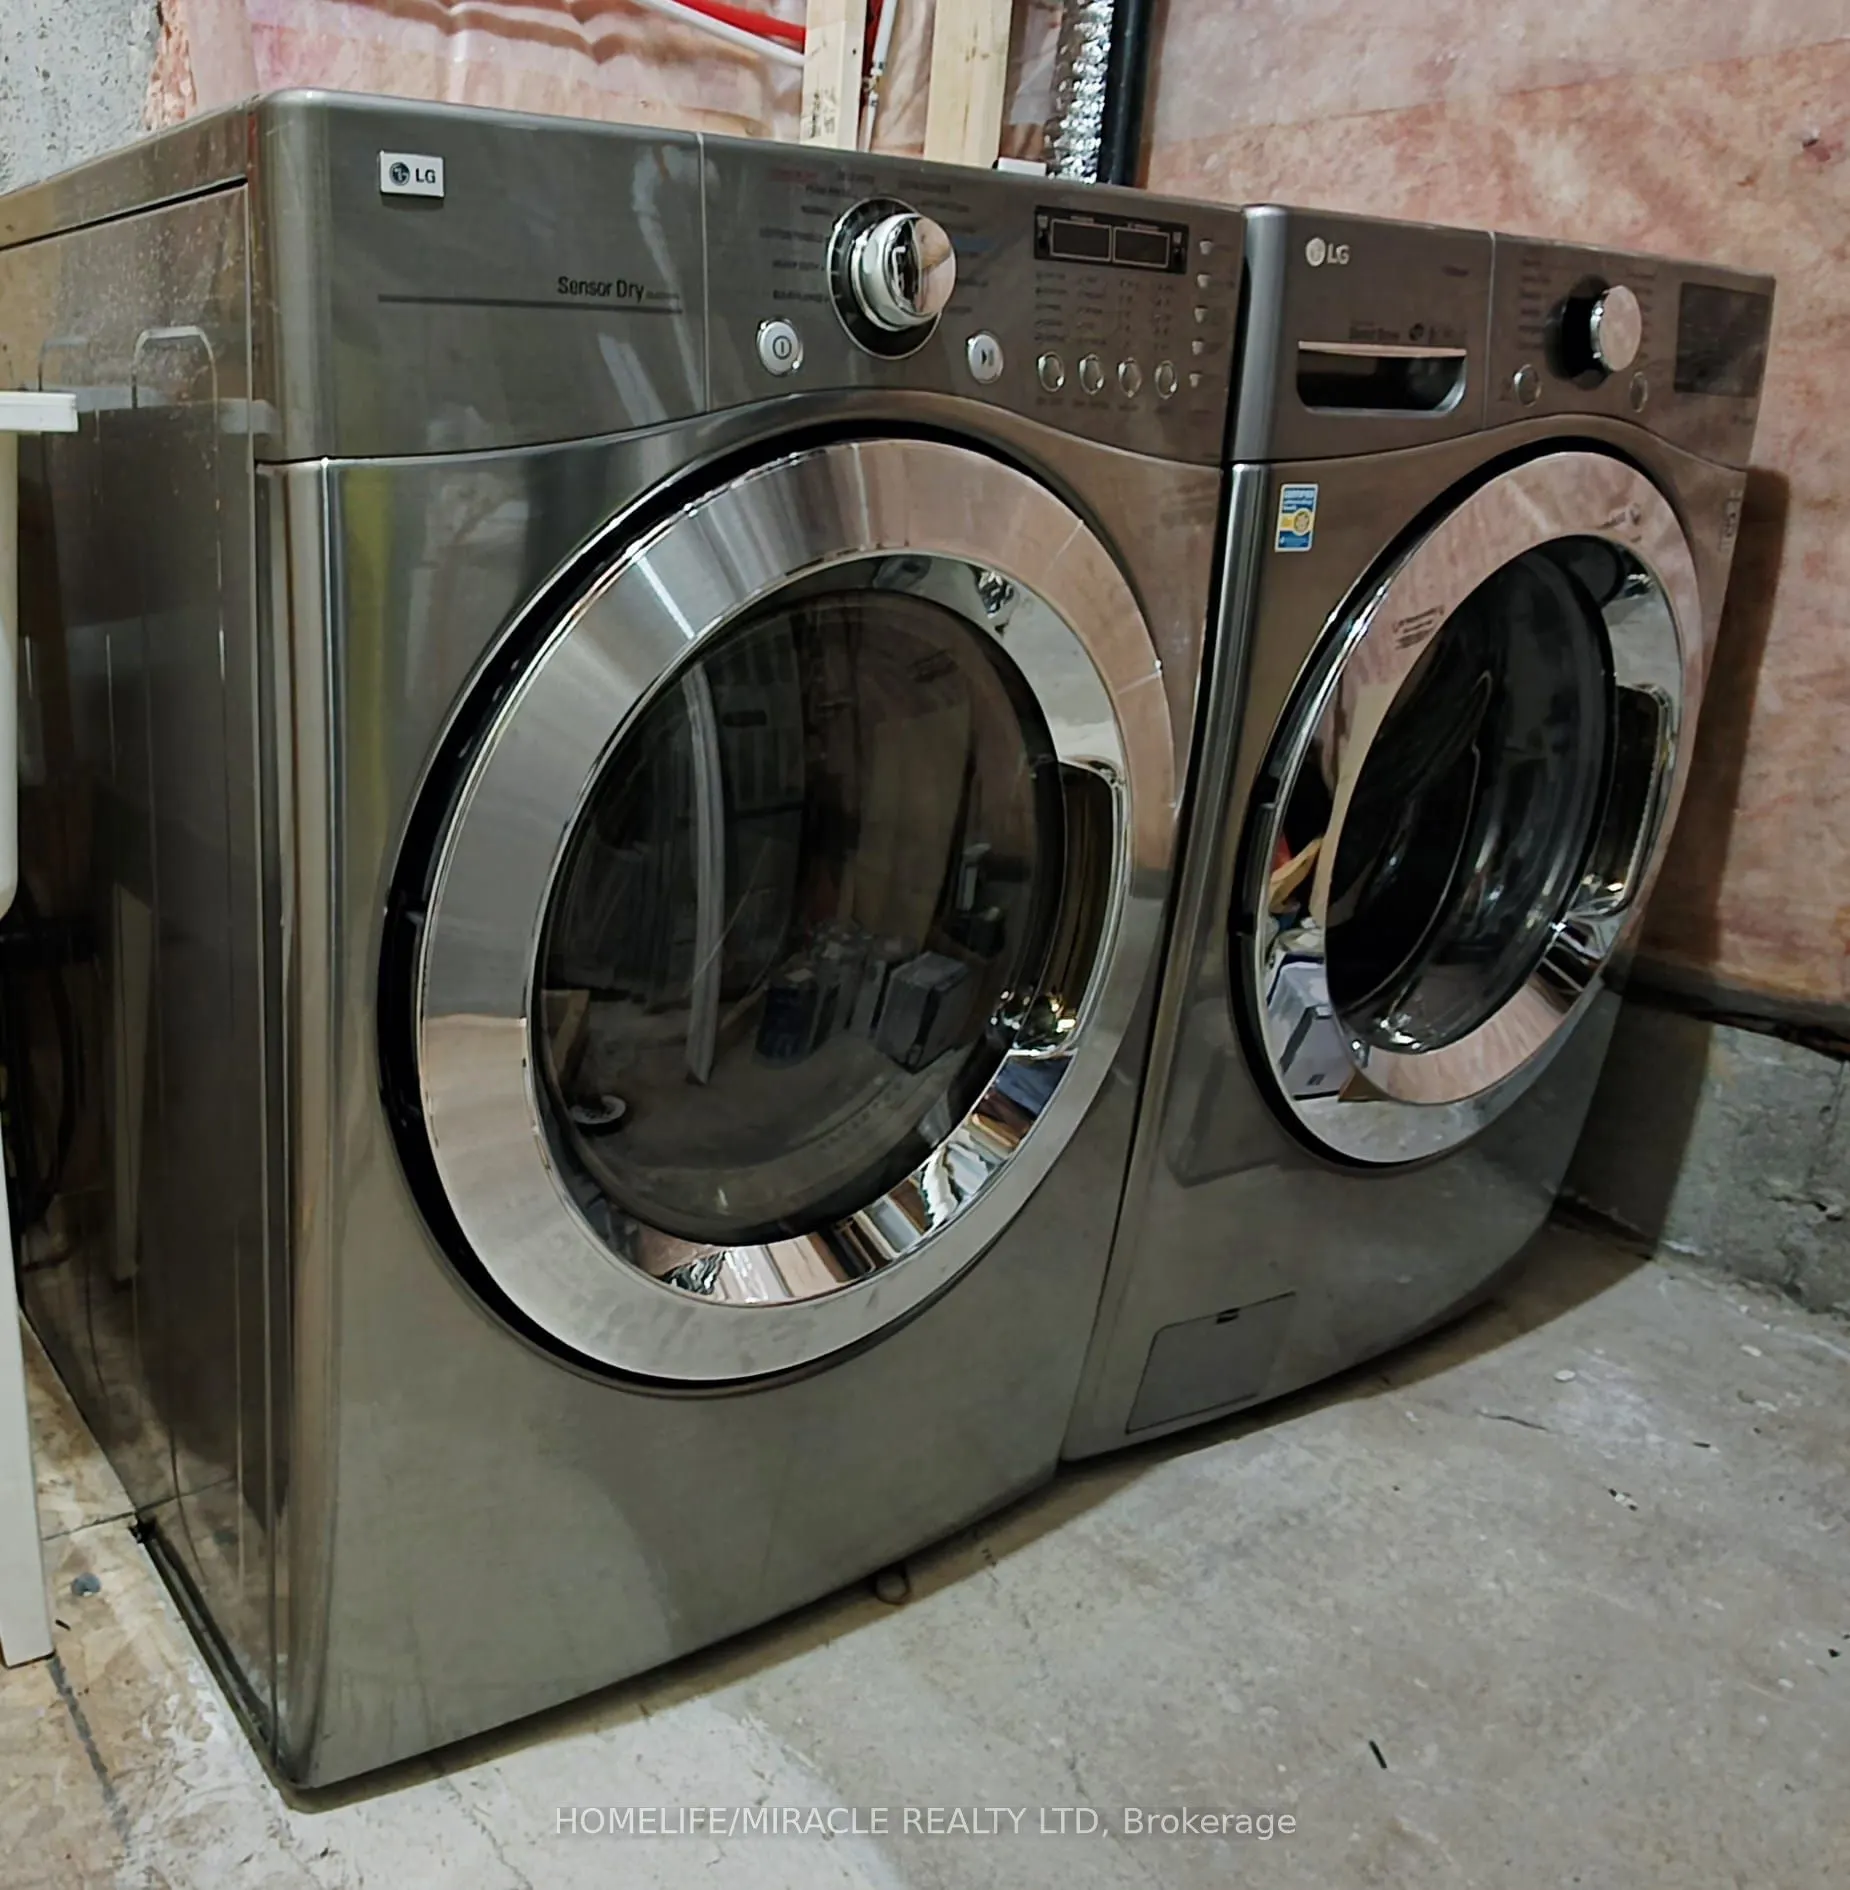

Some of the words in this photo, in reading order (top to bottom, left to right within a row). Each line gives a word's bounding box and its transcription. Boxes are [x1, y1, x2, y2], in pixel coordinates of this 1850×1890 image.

[415, 168, 436, 184] LG
[1326, 244, 1350, 265] LG
[557, 276, 613, 297] Sensor
[615, 279, 645, 303] Dry
